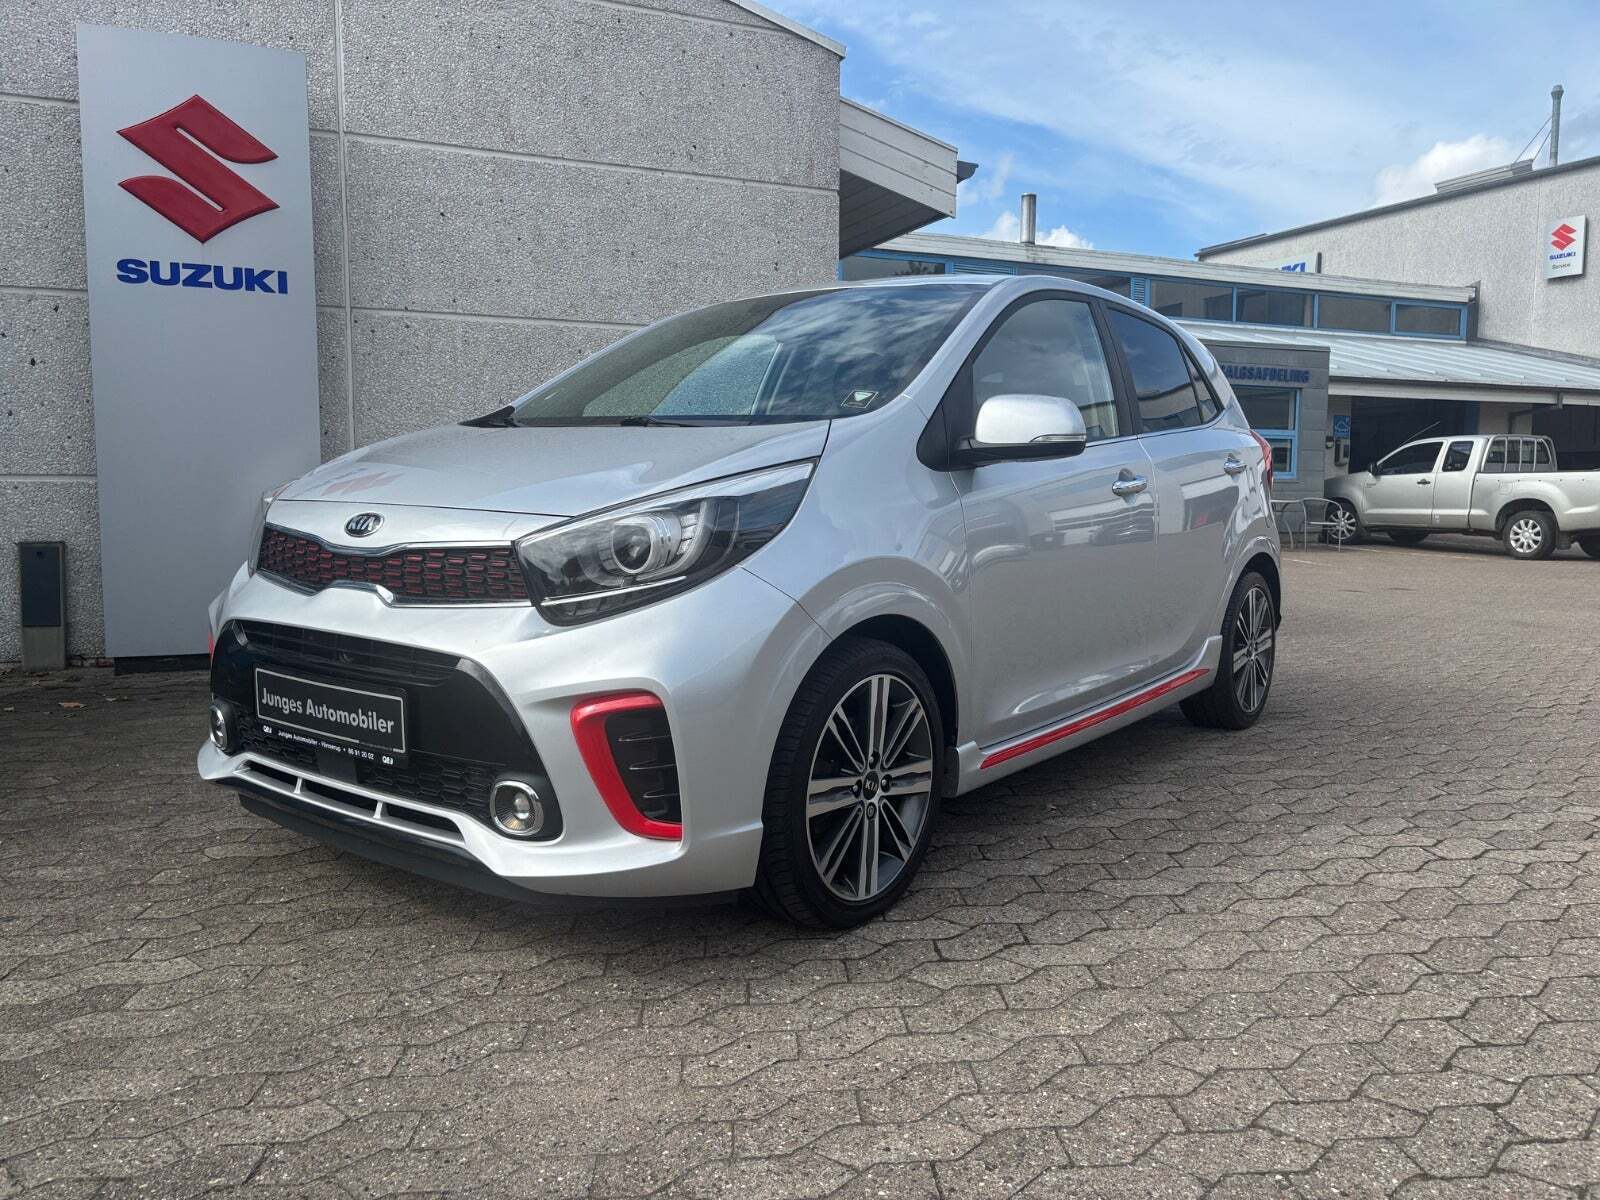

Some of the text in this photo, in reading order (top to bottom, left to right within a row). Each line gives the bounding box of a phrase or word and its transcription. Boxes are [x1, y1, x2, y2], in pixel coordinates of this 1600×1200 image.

[1549, 252, 1577, 260] SUZUKI
[116, 258, 289, 294] SUZUKI
[262, 687, 395, 733] Junges Automobiler
[865, 779, 878, 791] KIA
